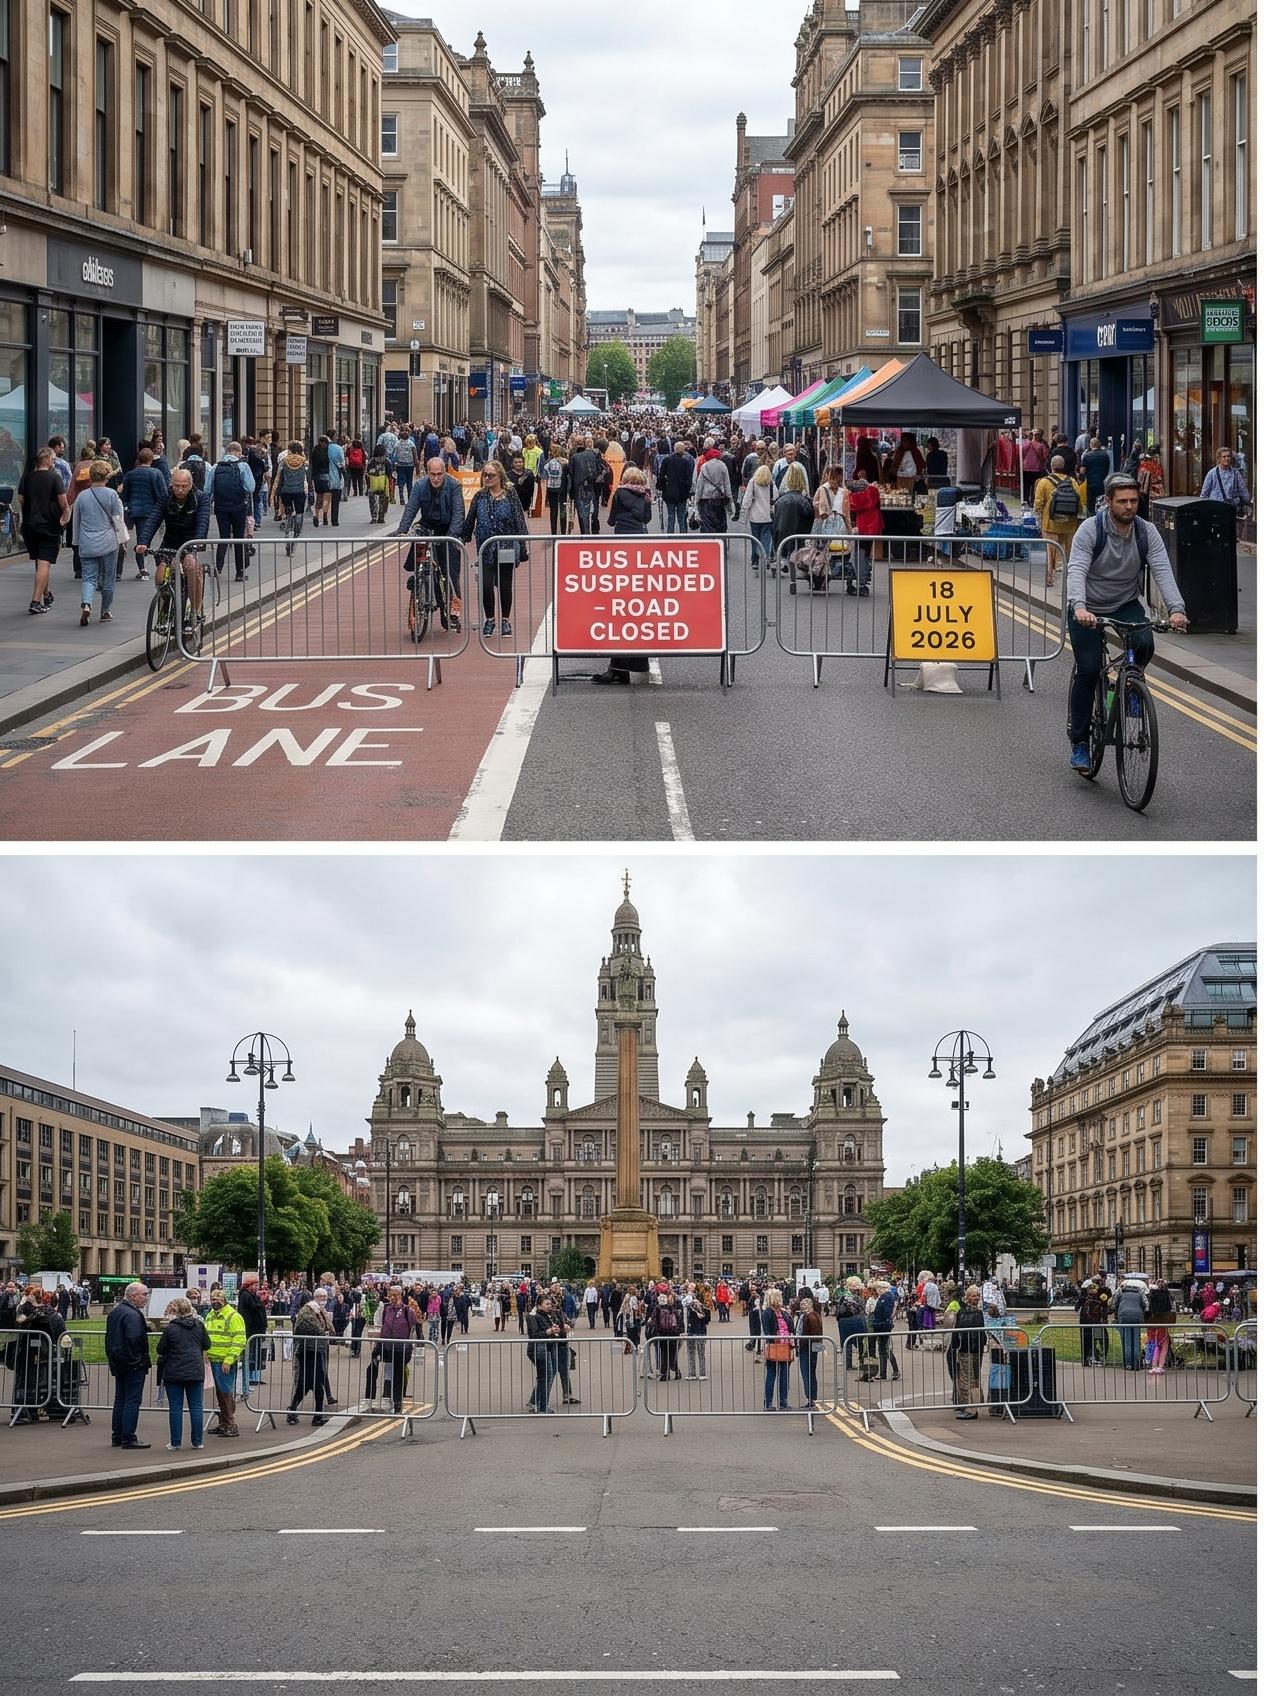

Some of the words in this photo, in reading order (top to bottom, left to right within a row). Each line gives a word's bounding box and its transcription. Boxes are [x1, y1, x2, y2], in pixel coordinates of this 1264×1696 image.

[579, 550, 628, 569] BUS
[636, 550, 700, 569] LANE
[564, 574, 715, 593] SUSPENDED
[929, 581, 954, 599] 18
[611, 598, 680, 617] ROAD
[913, 605, 973, 623] JULY
[590, 622, 689, 641] CLOSED
[911, 630, 976, 649] 2026
[173, 683, 415, 713] BUS
[51, 727, 424, 769] LANE
